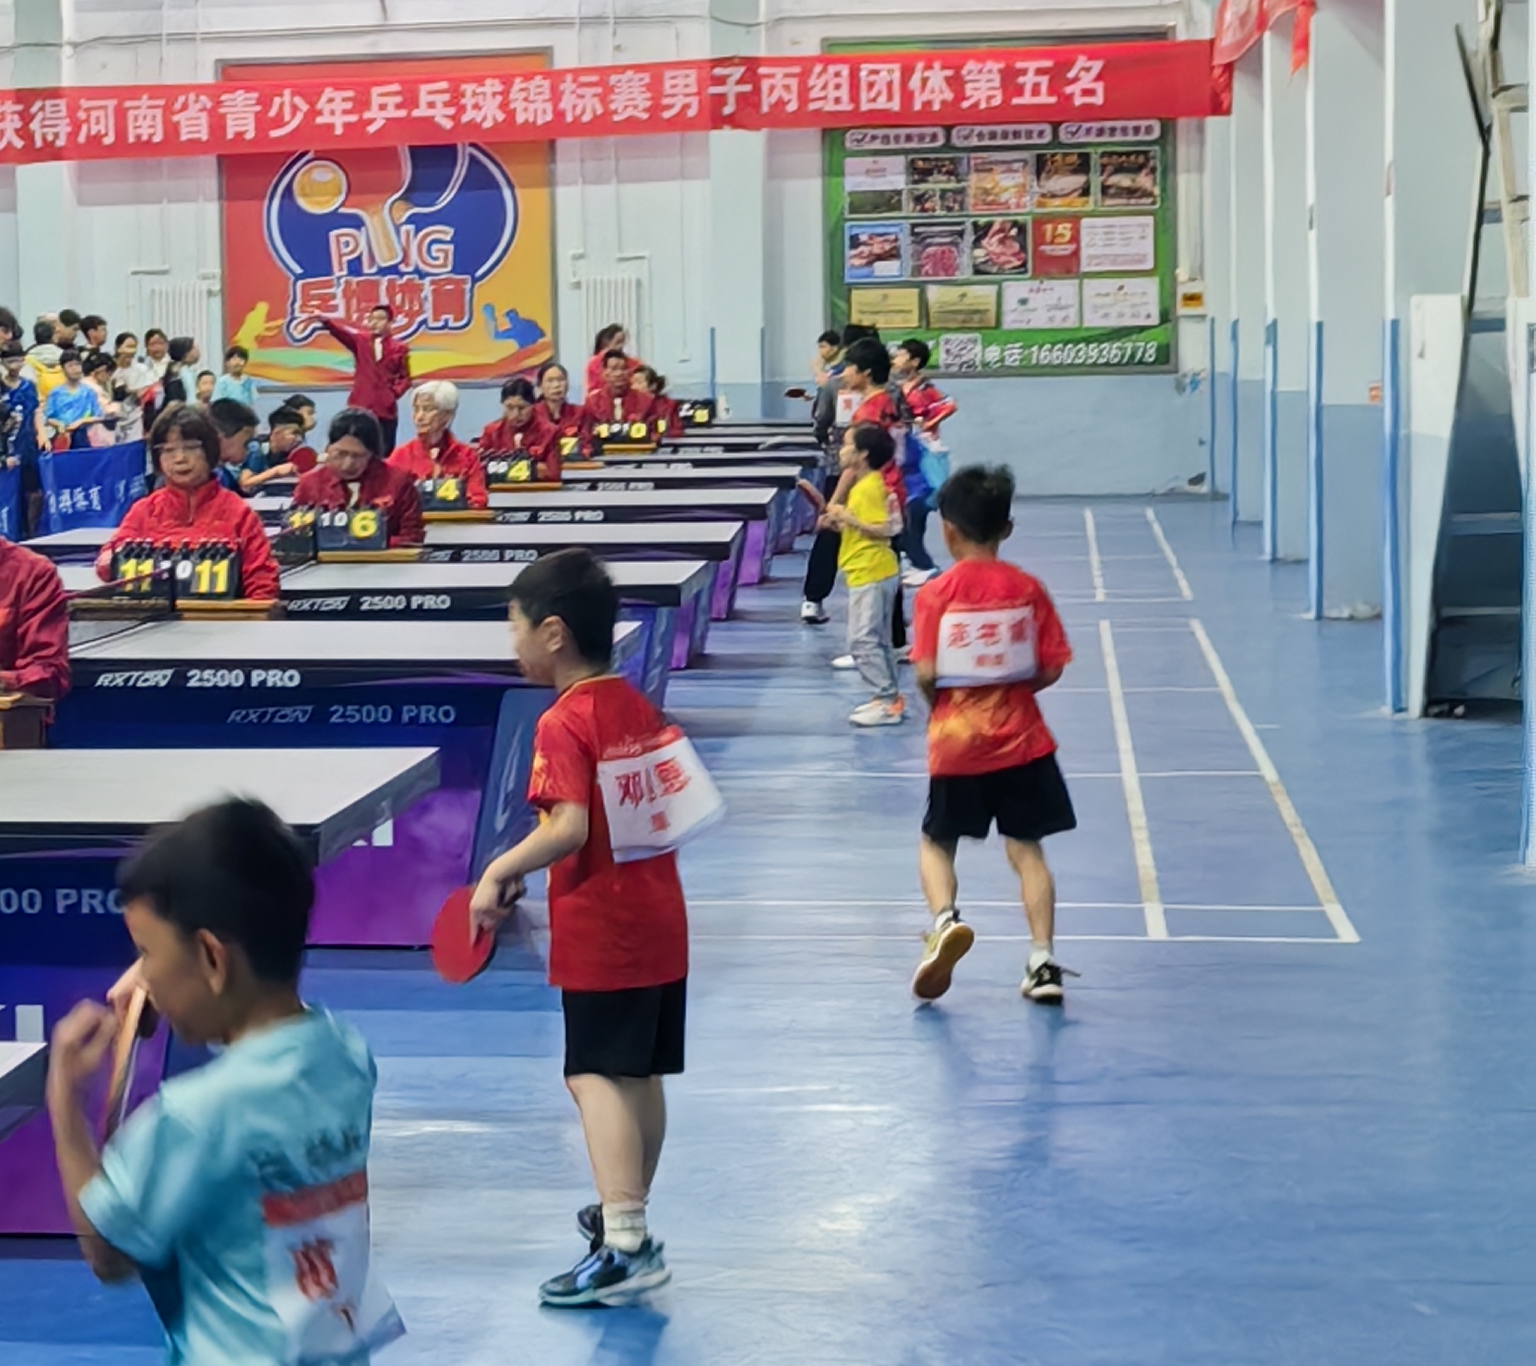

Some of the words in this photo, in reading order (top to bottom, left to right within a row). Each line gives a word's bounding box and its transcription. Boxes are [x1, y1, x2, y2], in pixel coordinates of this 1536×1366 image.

[436, 477, 460, 501] 4
[351, 510, 378, 538] 6
[195, 559, 229, 593] 11
[359, 596, 406, 611] 2500
[411, 595, 450, 611] PRO
[186, 670, 244, 688] 2500
[250, 669, 301, 688] PRO
[329, 706, 392, 724] 2500
[401, 705, 456, 724] PRO
